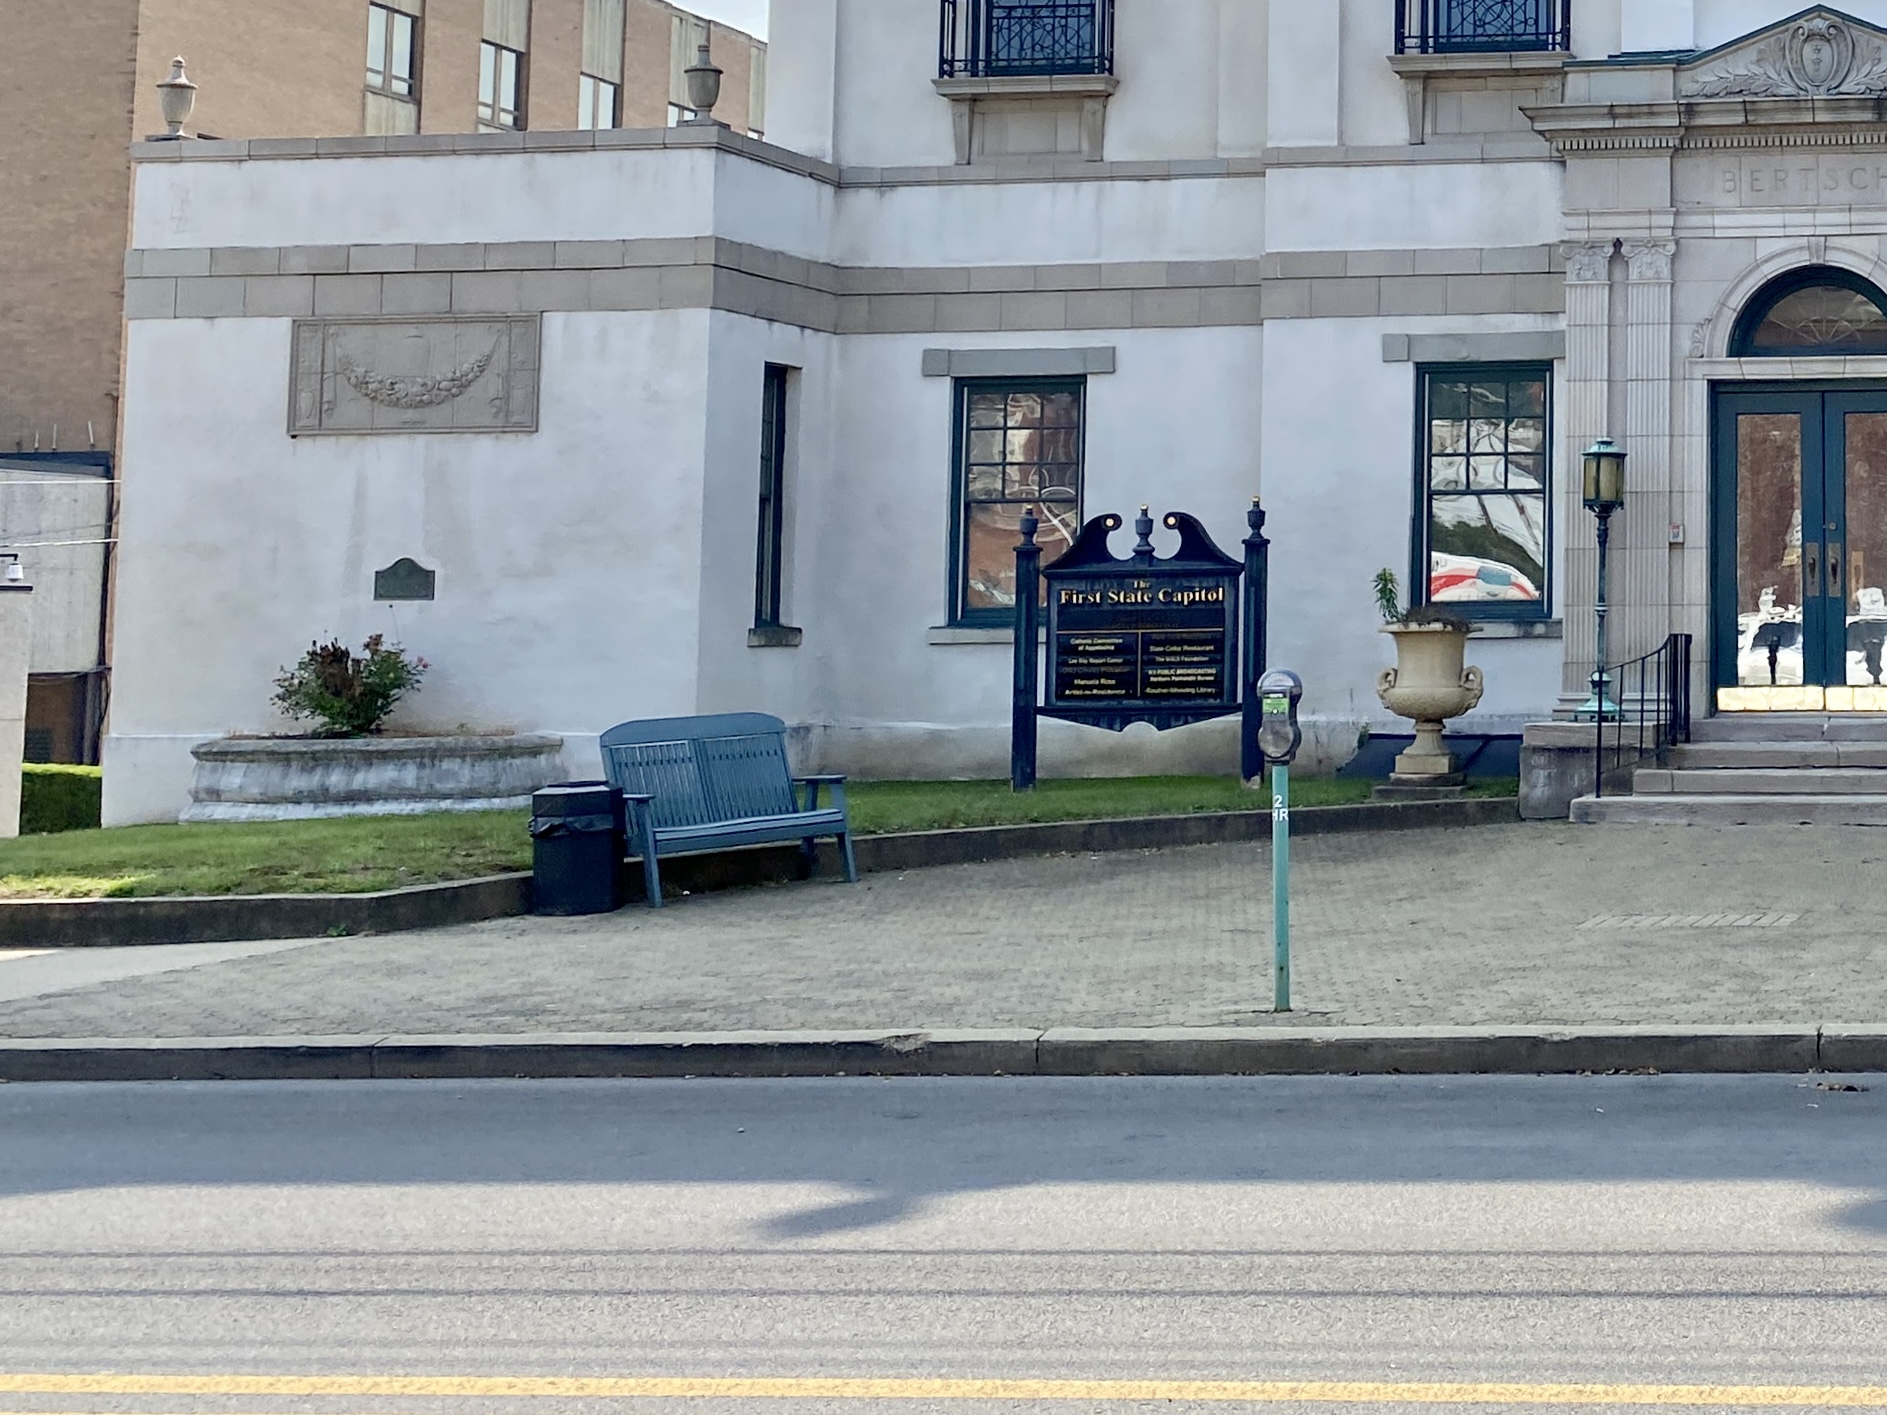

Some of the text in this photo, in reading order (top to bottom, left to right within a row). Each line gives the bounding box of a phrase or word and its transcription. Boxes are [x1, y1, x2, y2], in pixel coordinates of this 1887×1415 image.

[1133, 580, 1150, 589] The
[1059, 587, 1224, 606] First State Capitol
[1274, 794, 1283, 808] 2
[1272, 808, 1289, 822] HR
